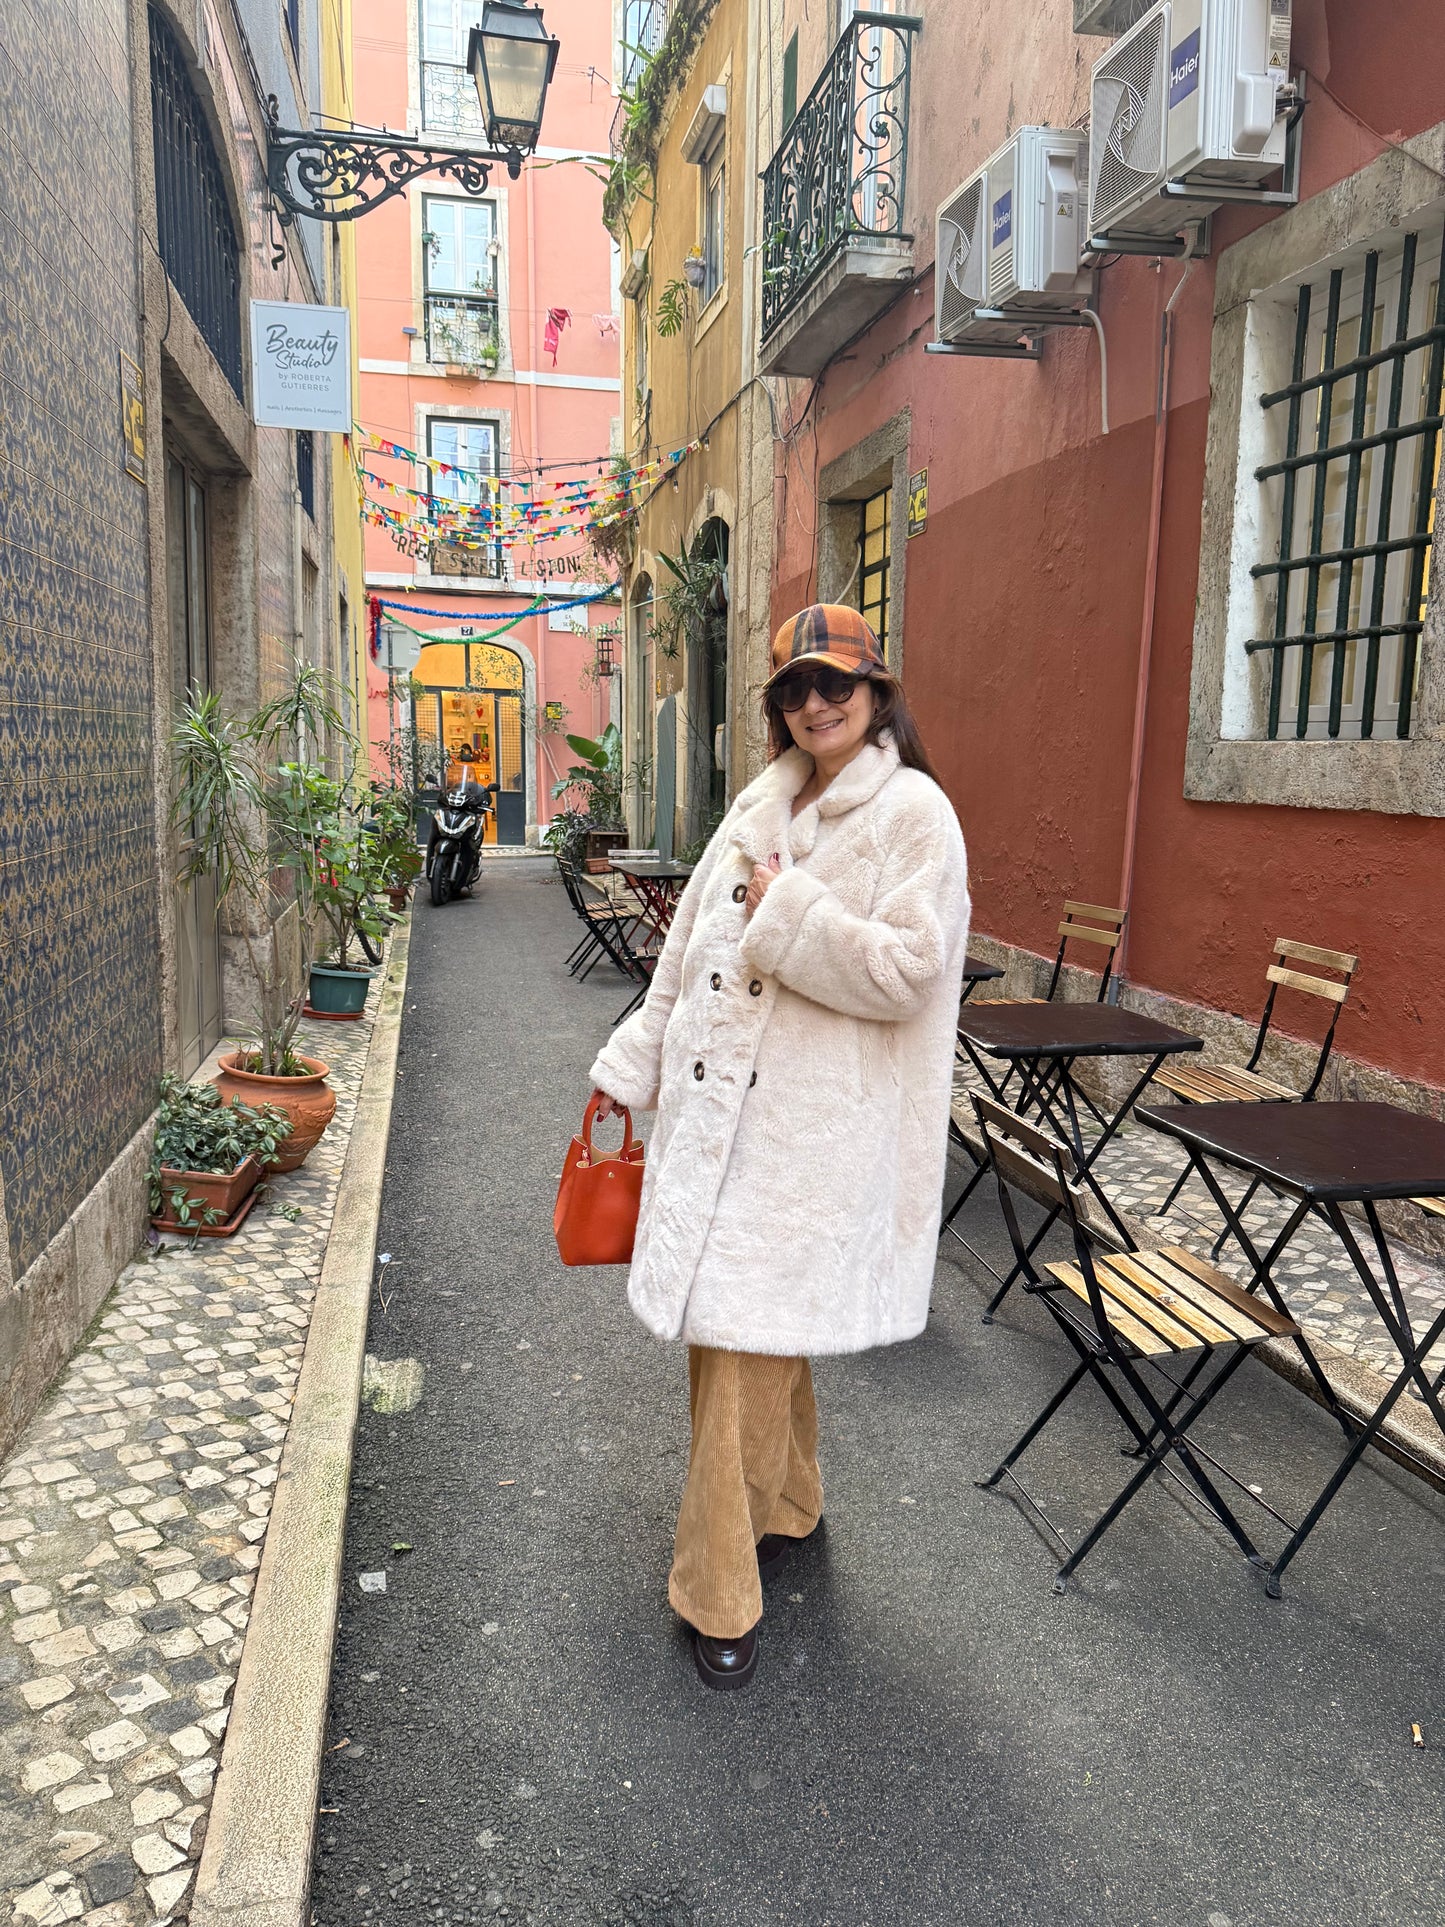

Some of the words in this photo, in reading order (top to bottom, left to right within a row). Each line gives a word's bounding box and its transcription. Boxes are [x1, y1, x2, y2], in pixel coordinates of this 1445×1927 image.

[1170, 52, 1199, 88] Haier
[993, 208, 1012, 233] Haier
[266, 324, 338, 366] Beauty
[275, 349, 322, 369] Studio
[278, 372, 288, 381] by
[291, 373, 332, 382] ROBERTA
[281, 381, 330, 392] GUTIERRES
[449, 552, 507, 576] SREET
